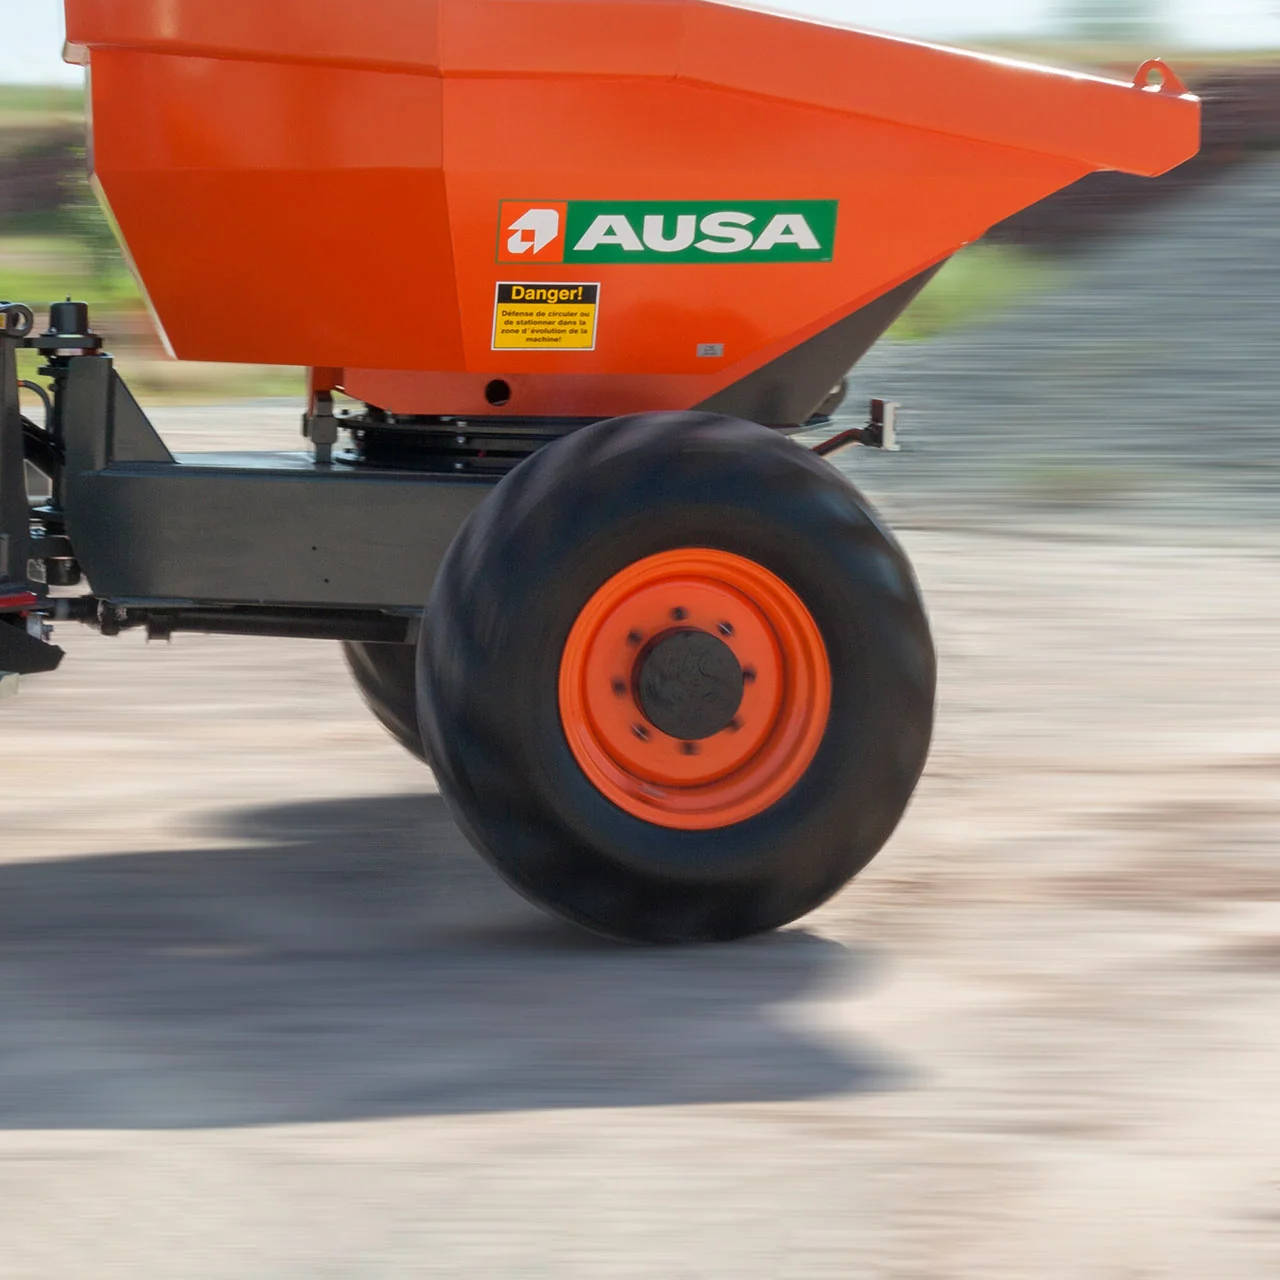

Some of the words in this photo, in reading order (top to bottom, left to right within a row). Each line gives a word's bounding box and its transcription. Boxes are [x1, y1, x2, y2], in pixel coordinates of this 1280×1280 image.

[573, 211, 822, 253] AUSA
[511, 285, 583, 304] Danger!
[536, 310, 546, 318] de
[548, 310, 578, 318] circuler
[501, 327, 520, 335] zone
[569, 327, 578, 335] de
[581, 327, 587, 335] la
